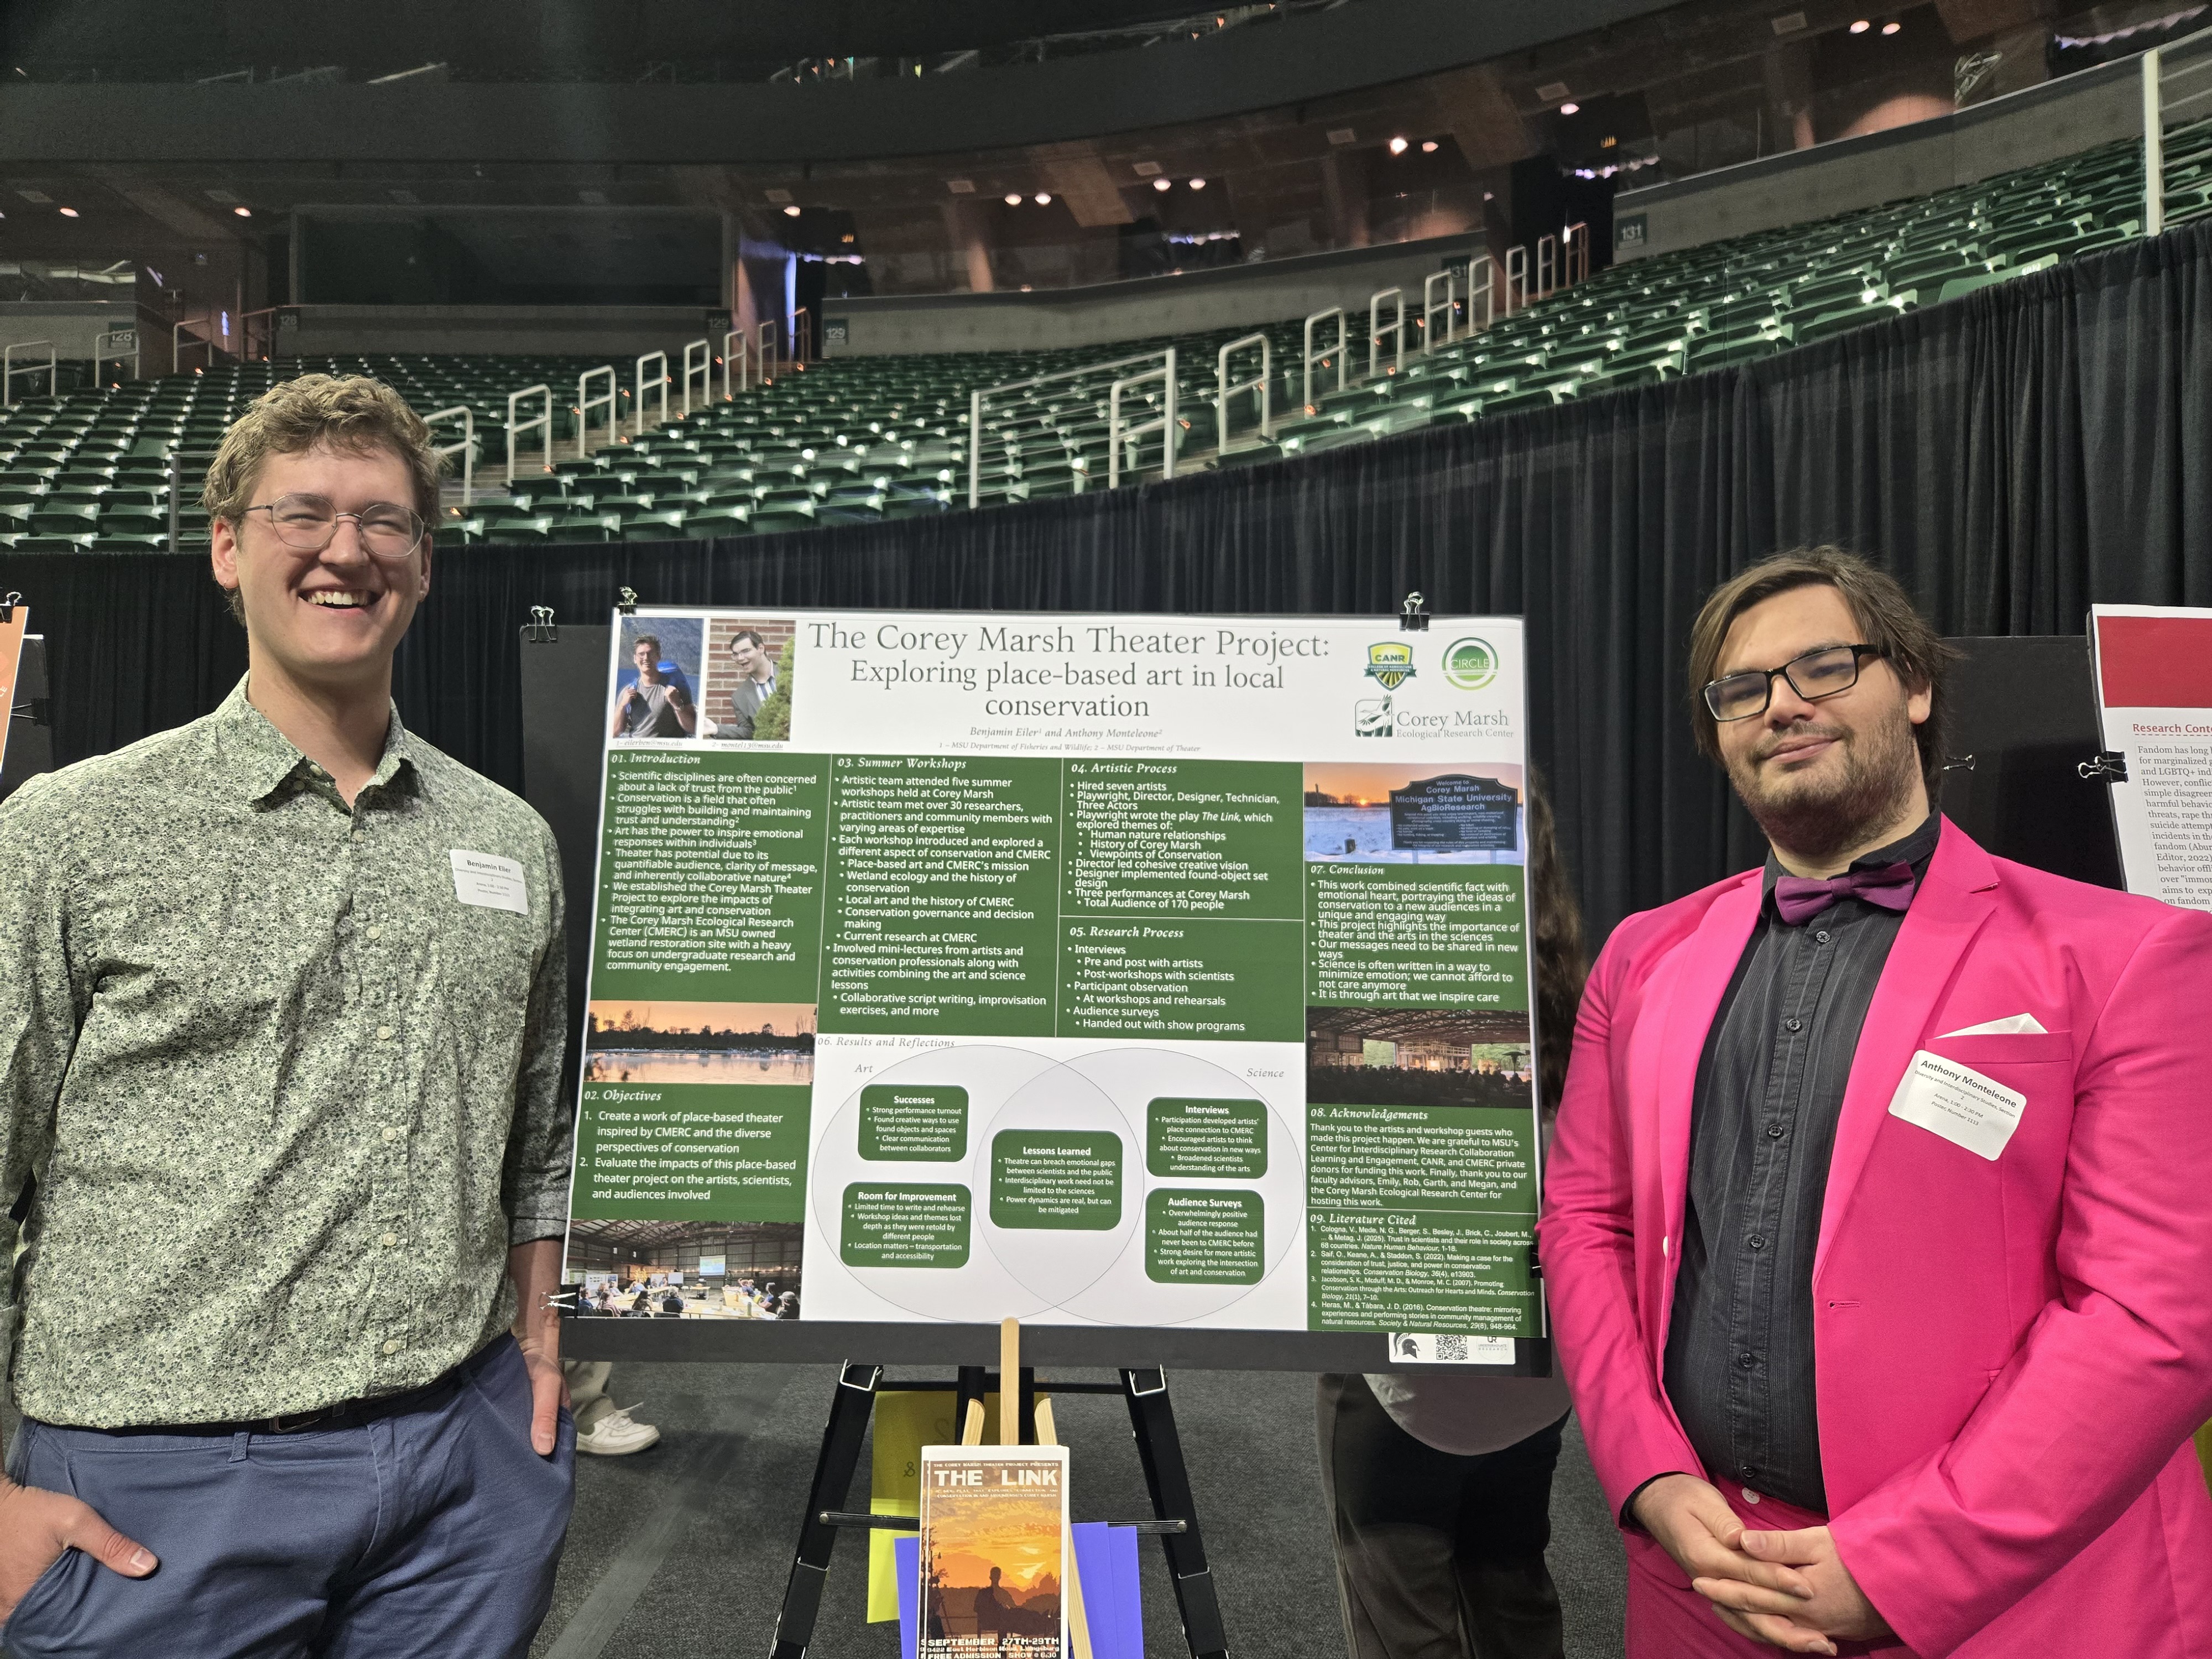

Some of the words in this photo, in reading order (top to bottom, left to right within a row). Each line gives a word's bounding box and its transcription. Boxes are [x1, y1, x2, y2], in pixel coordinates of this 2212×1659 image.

[1621, 222, 1642, 240] 131
[826, 327, 845, 338] 129
[808, 623, 867, 650] The
[877, 624, 967, 659] Corey
[978, 627, 1074, 654] Marsh
[1086, 628, 1205, 655] Theater
[1217, 629, 1329, 665] Project:
[1451, 658, 1490, 669] CIRCLE
[851, 660, 977, 690] Exploring
[987, 661, 1137, 687] place-based
[1146, 666, 1182, 687] art
[1193, 664, 1216, 687] in
[1225, 666, 1285, 689] local
[985, 693, 1150, 718] conservation
[1397, 711, 1448, 731] Corey
[1454, 709, 1509, 726] Marsh
[970, 727, 1013, 739] Benjamin
[1045, 729, 1062, 738] and
[1065, 729, 1103, 739] Anthony
[2133, 724, 2181, 732] Research
[1397, 729, 1441, 740] Ecological
[1443, 729, 1482, 738] Research
[1485, 729, 1514, 738] Center
[2191, 746, 2209, 755] long
[612, 754, 627, 763] 01.
[630, 754, 701, 764] Introduction
[837, 758, 854, 768] 03.
[858, 758, 903, 769] Summer
[907, 758, 967, 770] Workshops
[2154, 758, 2206, 766] marginalized
[1072, 765, 1088, 774] 04.
[1091, 763, 1133, 774] Artistic
[1137, 764, 1177, 774] Process
[2159, 768, 2195, 776] LGBTQ+
[843, 775, 877, 785] Artistic
[906, 776, 950, 786] attended
[952, 776, 969, 786] five
[1078, 781, 1104, 790] Hired
[1137, 782, 1166, 791] artists
[2144, 789, 2172, 798] simple
[1396, 796, 1433, 804] Michigan
[1421, 804, 1485, 812] AgBioResearch
[2148, 810, 2180, 819] threats,
[467, 859, 497, 870] Benjamin
[1329, 865, 1384, 875] Conclusion
[1070, 928, 1086, 937] 05.
[1090, 927, 1139, 938] Research
[1143, 927, 1184, 938] Process
[1075, 945, 1126, 954] Interviews
[1074, 982, 1127, 994] Participant
[1130, 983, 1188, 993] observation
[818, 1038, 832, 1046] 06.
[837, 1037, 872, 1046] Results
[876, 1038, 895, 1046] and
[899, 1038, 955, 1048] Reflections
[855, 1064, 873, 1073] Art
[1246, 1068, 1285, 1078] Science
[1921, 1060, 1961, 1081] Anthony
[1963, 1076, 2016, 1108] Monteleone
[585, 1091, 599, 1100] 02.
[603, 1089, 662, 1103] Objectives
[894, 1095, 935, 1104] Successes
[1914, 1070, 1934, 1081] Diversity
[1944, 1082, 1980, 1101] Interdisciplinary
[1981, 1098, 1998, 1110] Studies,
[1999, 1107, 2015, 1118] Section
[1934, 1093, 1949, 1104] Arena,
[1186, 1105, 1229, 1115] Interviews
[1311, 1108, 1326, 1118] 08.
[1330, 1108, 1429, 1121] Acknowledgements
[1931, 1100, 1947, 1112] Poster,
[1948, 1108, 1966, 1120] Number
[1968, 1118, 1979, 1126] 1113
[1023, 1146, 1055, 1156] Lessons
[1057, 1146, 1091, 1156] Learned
[858, 1192, 883, 1200] Room
[885, 1192, 897, 1200] for
[899, 1192, 956, 1202] Improvement
[1168, 1197, 1207, 1207] Audience
[1209, 1198, 1241, 1209] Surveys
[1311, 1215, 1326, 1224] 09.
[1329, 1214, 1384, 1224] Literature
[1387, 1215, 1416, 1225] Cited
[934, 1470, 983, 1486] THE
[1001, 1470, 1057, 1486] LINK
